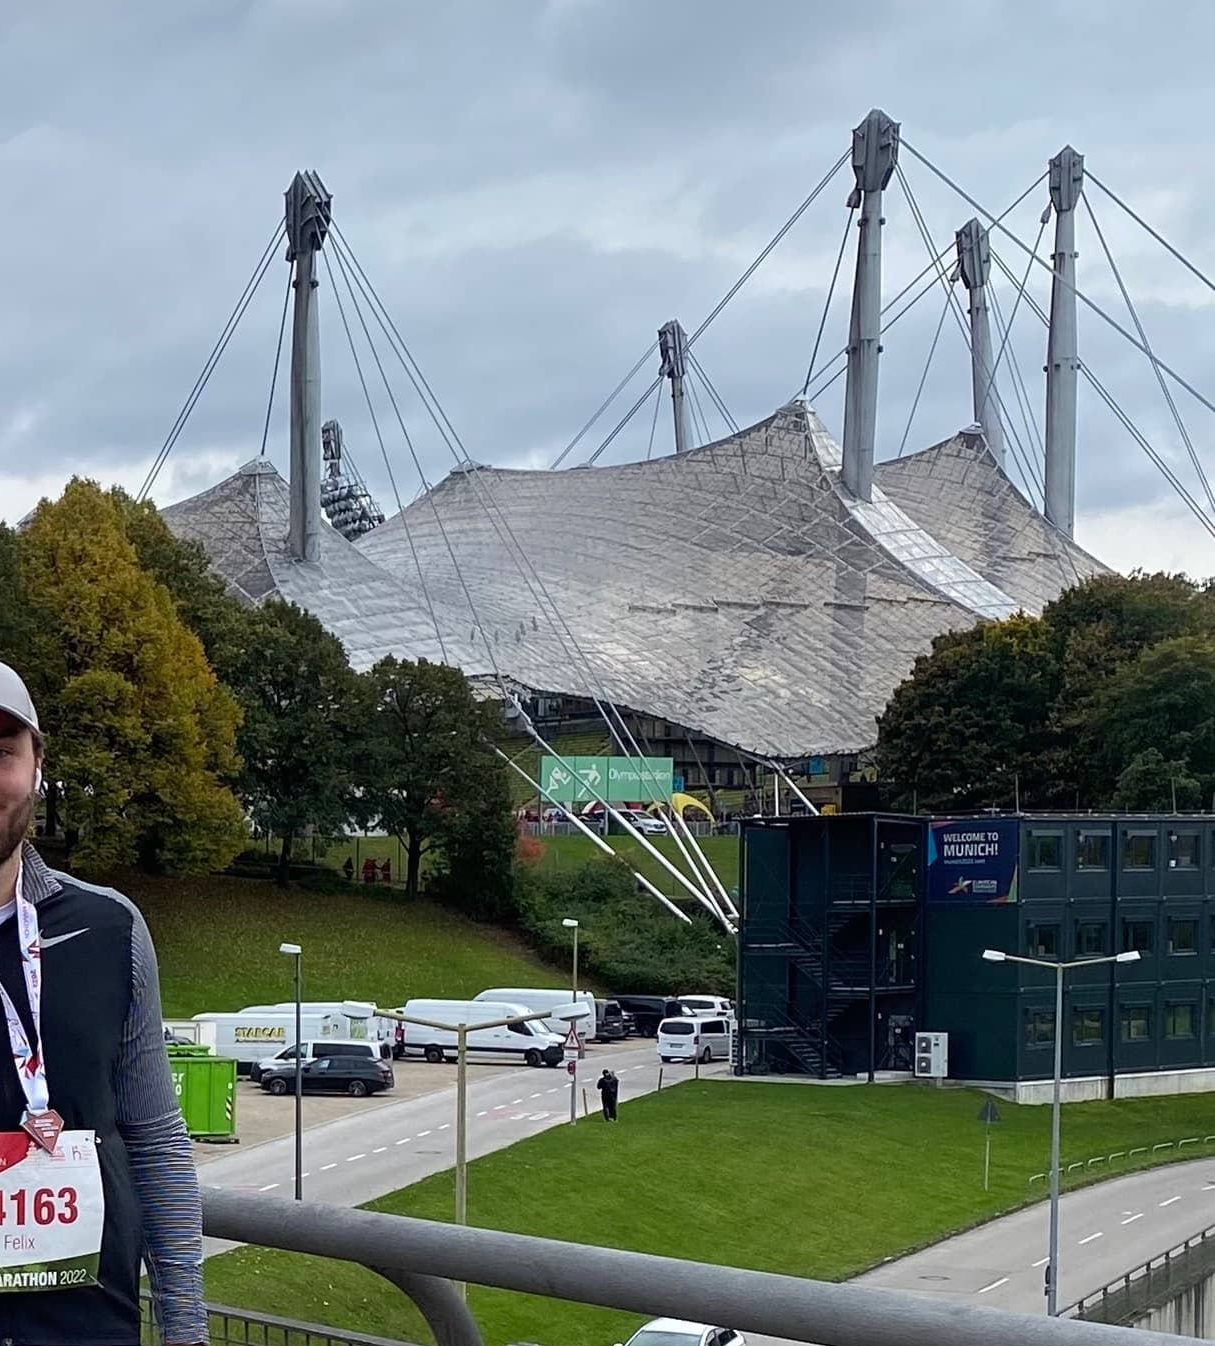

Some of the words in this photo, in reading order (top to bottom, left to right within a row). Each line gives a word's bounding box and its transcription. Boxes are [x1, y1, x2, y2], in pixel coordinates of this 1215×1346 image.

[943, 832, 986, 842] WELCOME
[987, 831, 999, 841] TO
[943, 843, 999, 857] MUNICH!
[4, 1234, 35, 1250] Felix
[59, 1268, 87, 1284] 2022
